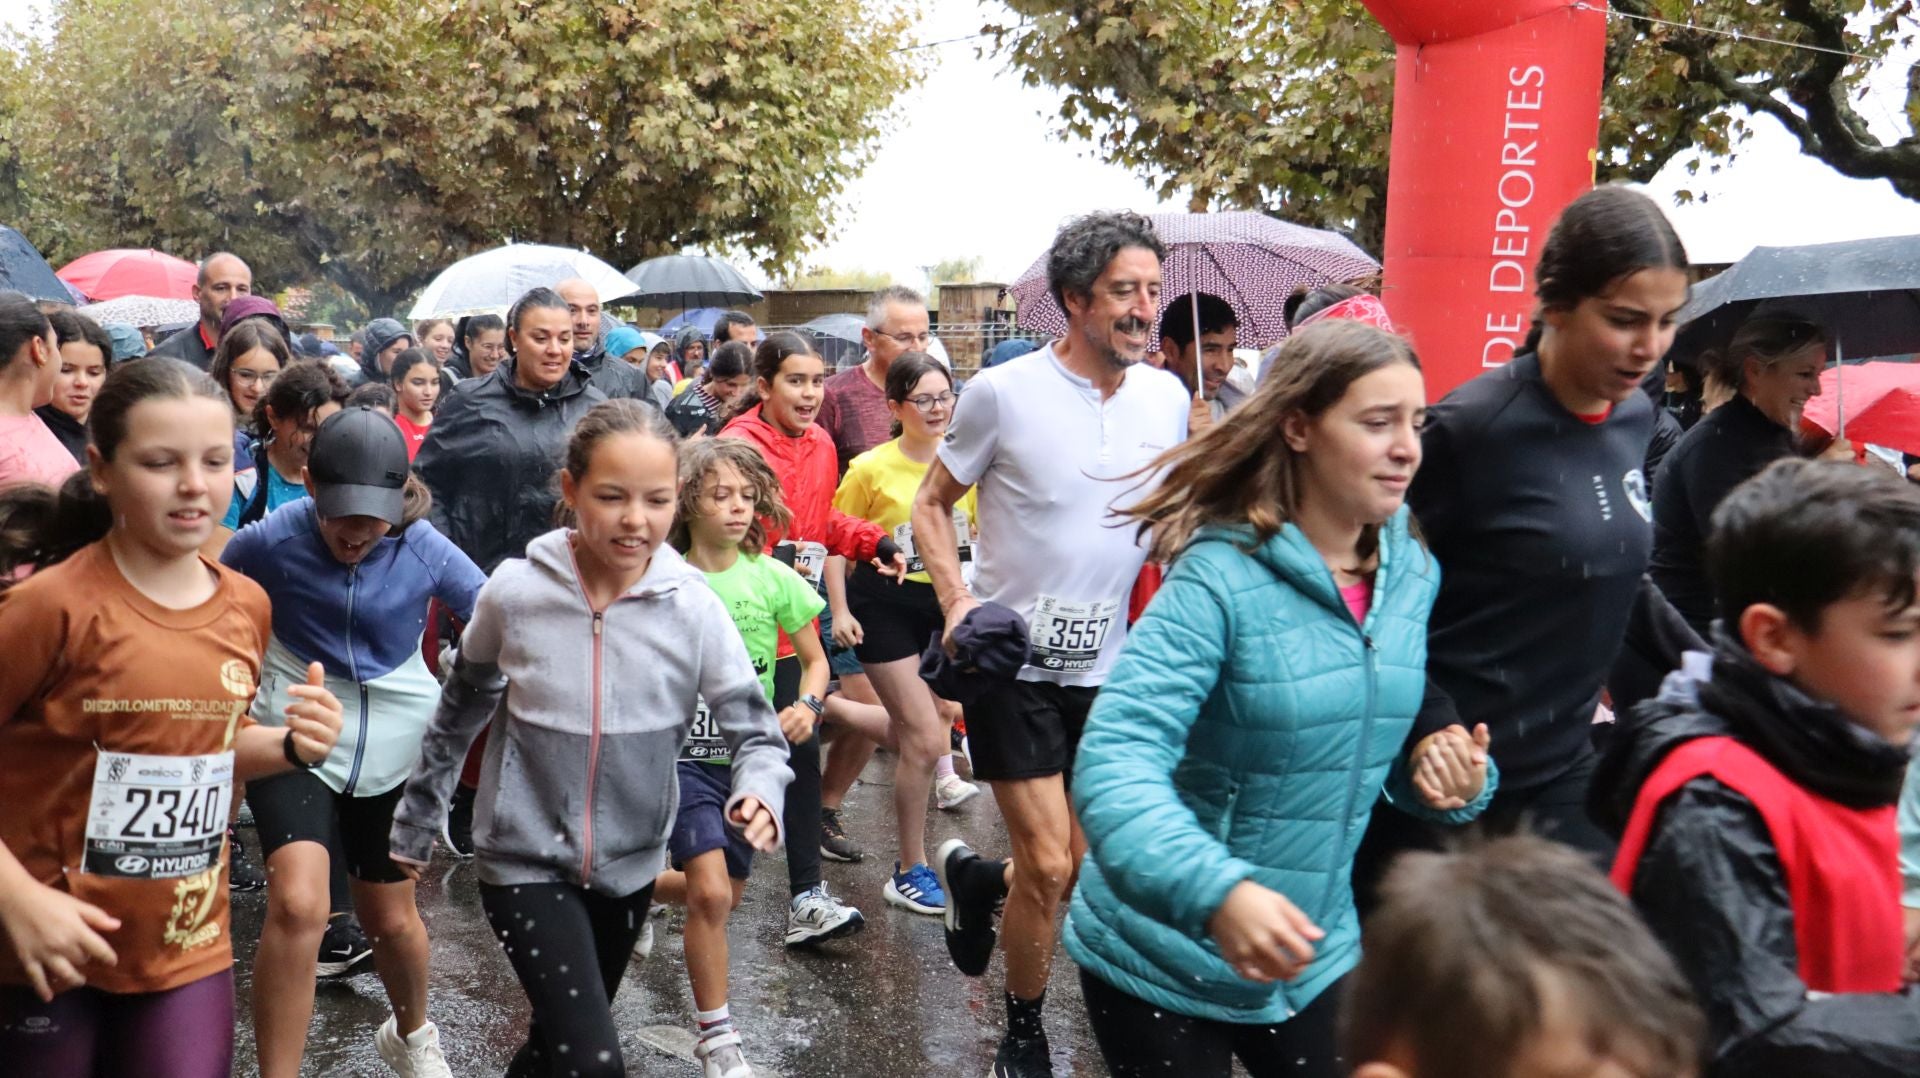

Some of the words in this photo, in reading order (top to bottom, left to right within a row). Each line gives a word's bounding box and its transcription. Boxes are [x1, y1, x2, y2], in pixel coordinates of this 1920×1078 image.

[1489, 64, 1545, 292] DEPORTES
[1481, 312, 1522, 369] DE
[1048, 617, 1109, 649] 3557
[120, 785, 220, 838] 2340
